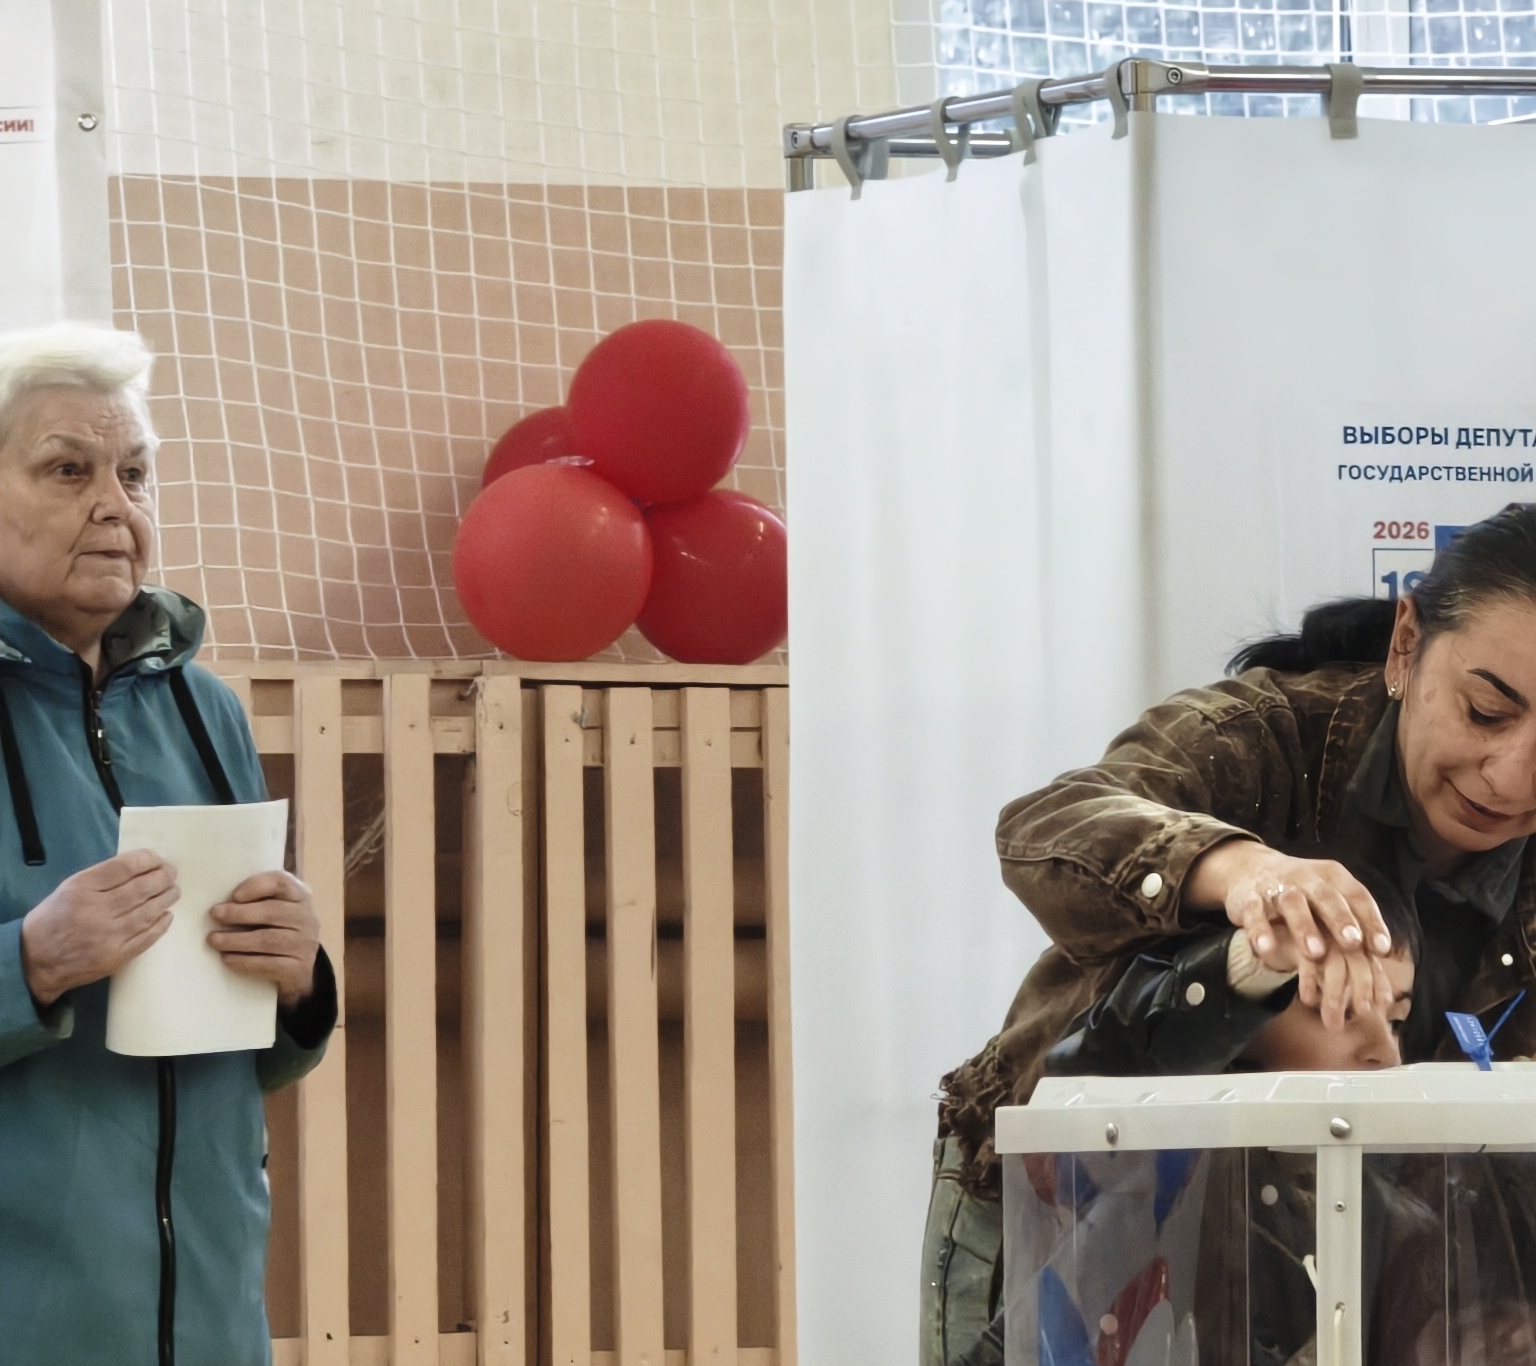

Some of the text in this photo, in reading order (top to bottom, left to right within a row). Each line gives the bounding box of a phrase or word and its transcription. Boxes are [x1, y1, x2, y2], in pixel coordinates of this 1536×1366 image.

[1343, 426, 1449, 446] ВЫБОРЫ
[1338, 463, 1533, 483] ГОСУДАРСТВЕННОЙ
[1373, 521, 1430, 540] 2026
